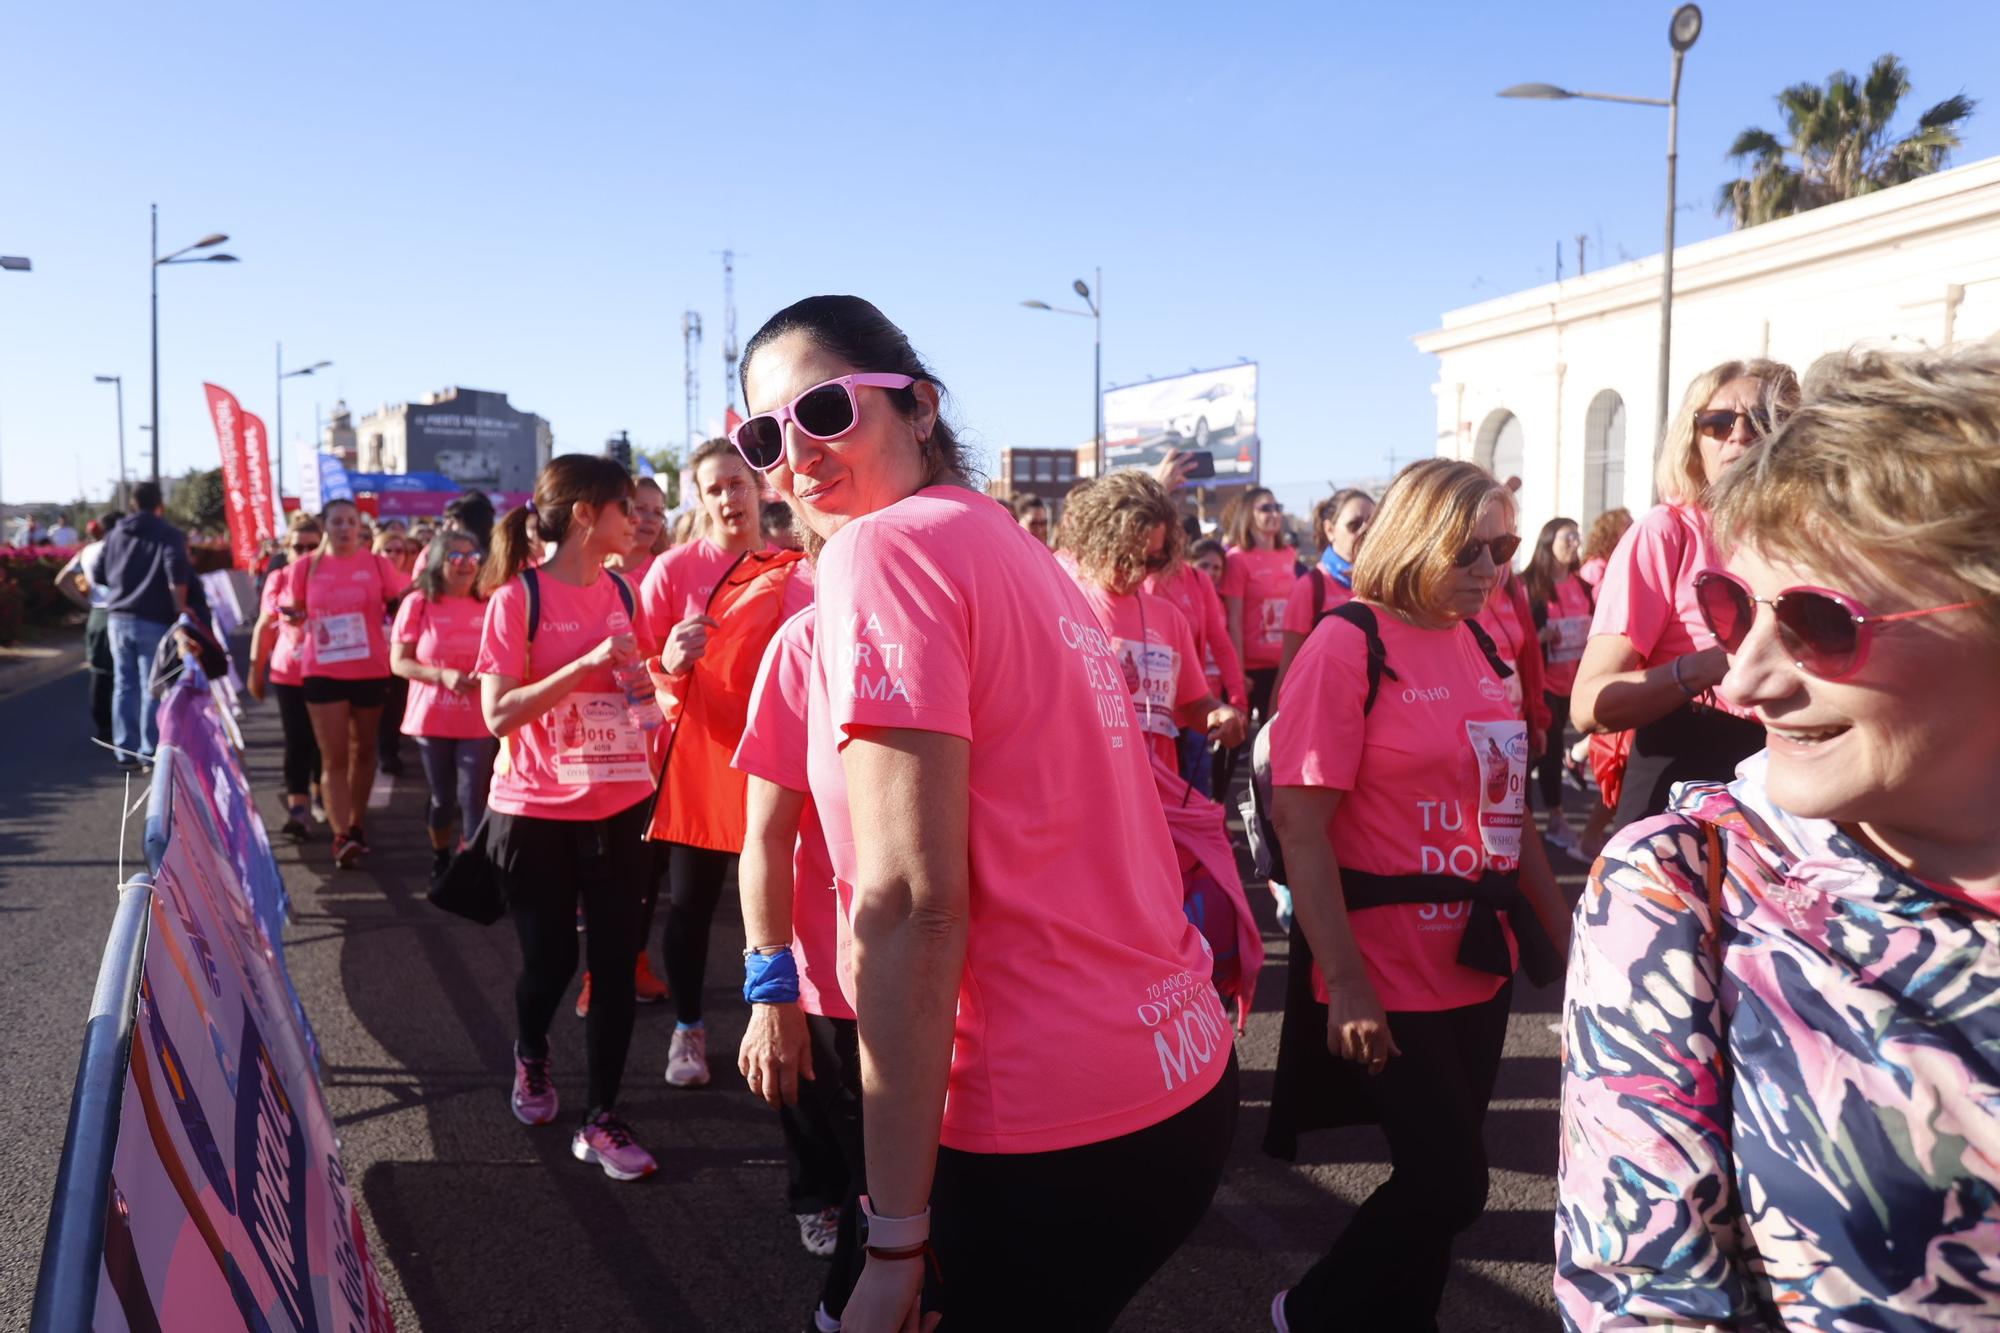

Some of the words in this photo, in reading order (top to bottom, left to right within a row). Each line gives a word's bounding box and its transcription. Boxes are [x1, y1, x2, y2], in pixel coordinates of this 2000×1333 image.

[880, 643, 903, 669] TI
[1142, 679, 1170, 694] 016
[588, 728, 616, 742] 016
[1417, 800, 1462, 832] TU
[1145, 983, 1160, 1000] 10
[1162, 969, 1192, 994] AÑOS
